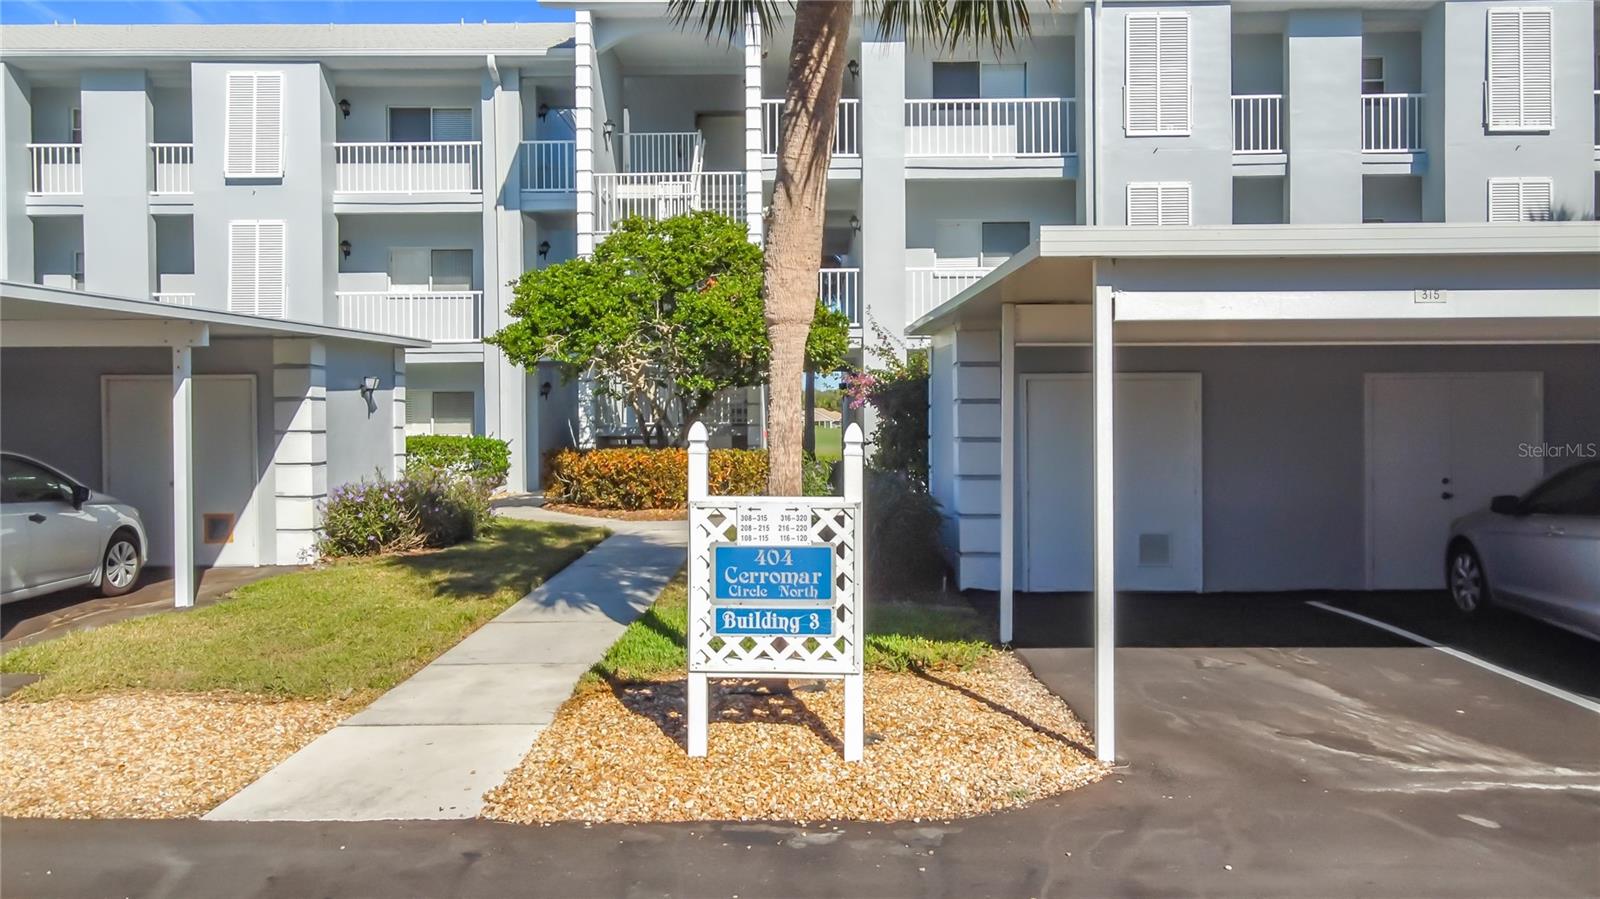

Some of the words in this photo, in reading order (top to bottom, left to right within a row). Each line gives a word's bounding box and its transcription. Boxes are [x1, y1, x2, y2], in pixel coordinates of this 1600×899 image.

[1422, 290, 1440, 300] 315
[754, 549, 794, 566] 404
[724, 566, 822, 586] Cerromar
[728, 585, 768, 597] Circle
[778, 585, 818, 599] North
[722, 610, 803, 634] Building
[809, 612, 820, 630] 3
